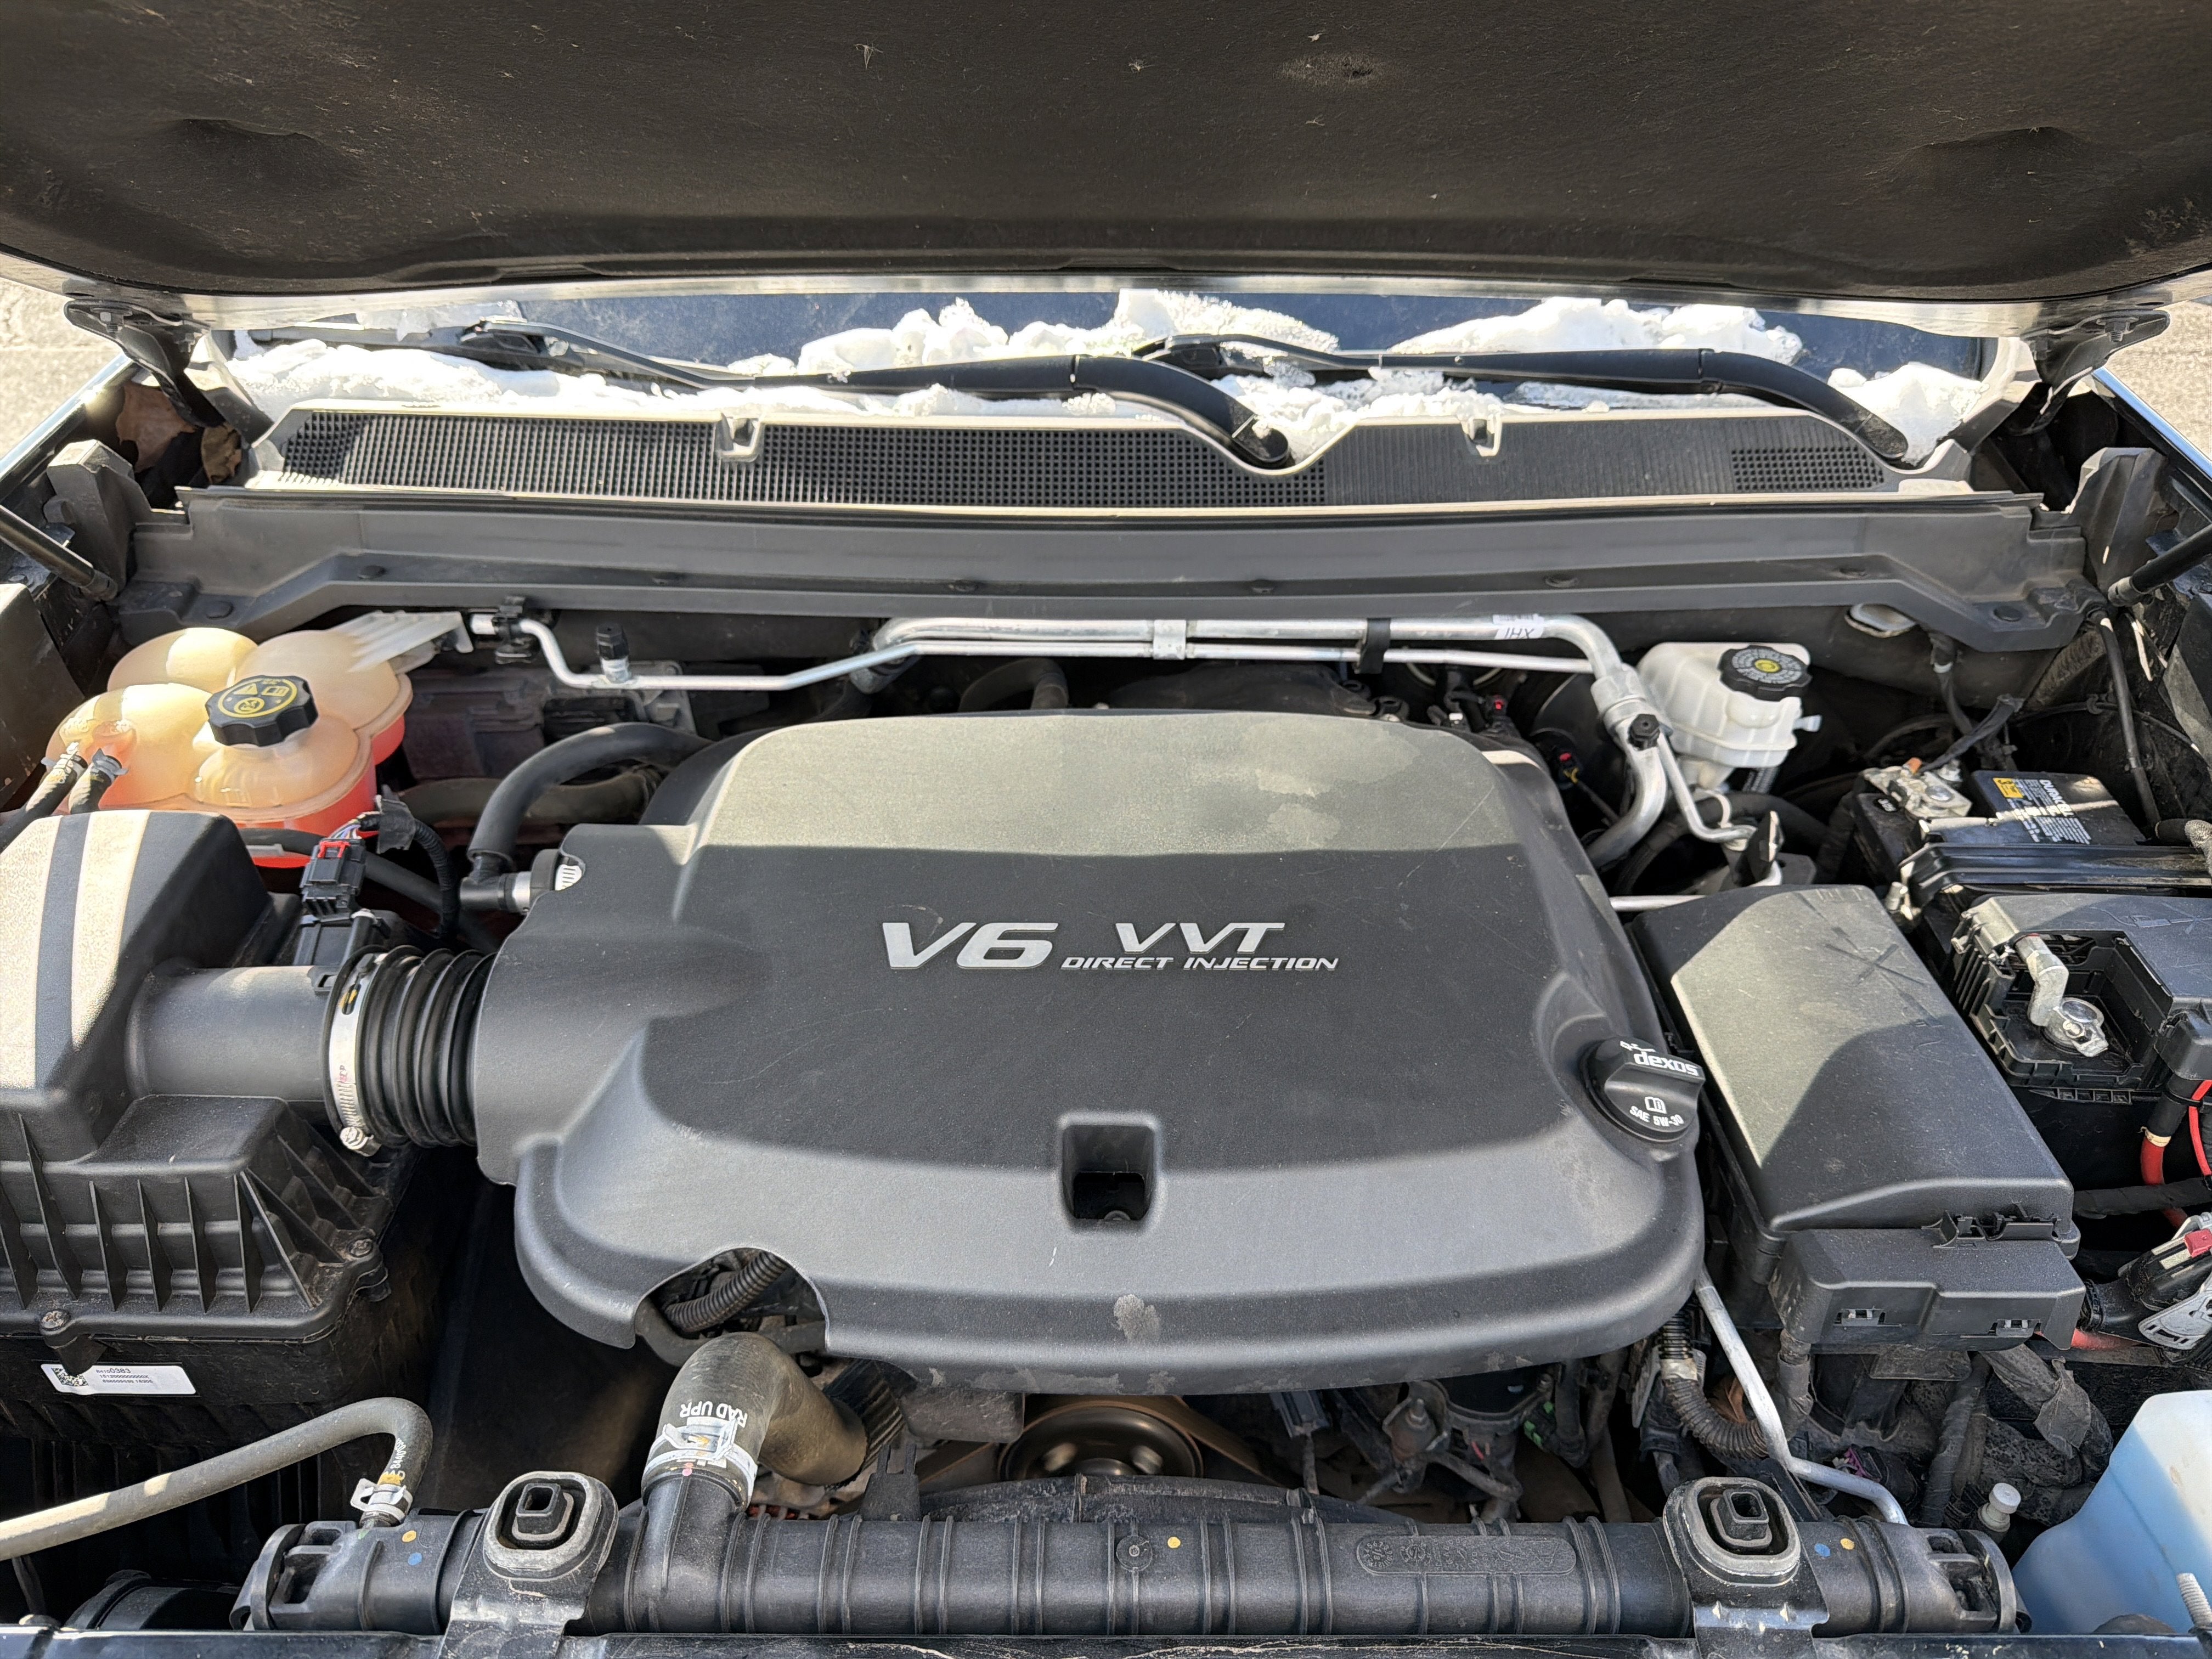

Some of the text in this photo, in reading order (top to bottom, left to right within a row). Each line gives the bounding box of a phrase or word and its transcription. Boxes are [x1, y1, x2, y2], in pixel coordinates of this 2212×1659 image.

[2039, 779, 2074, 817] DURACELL
[882, 922, 1285, 969] V6 VVT
[1061, 957, 1339, 971] DIRECT INJECTION
[1634, 1051, 1699, 1076] dexos
[1630, 1105, 1684, 1127] SAE 5W-30
[680, 1401, 748, 1427] RAD UPR
